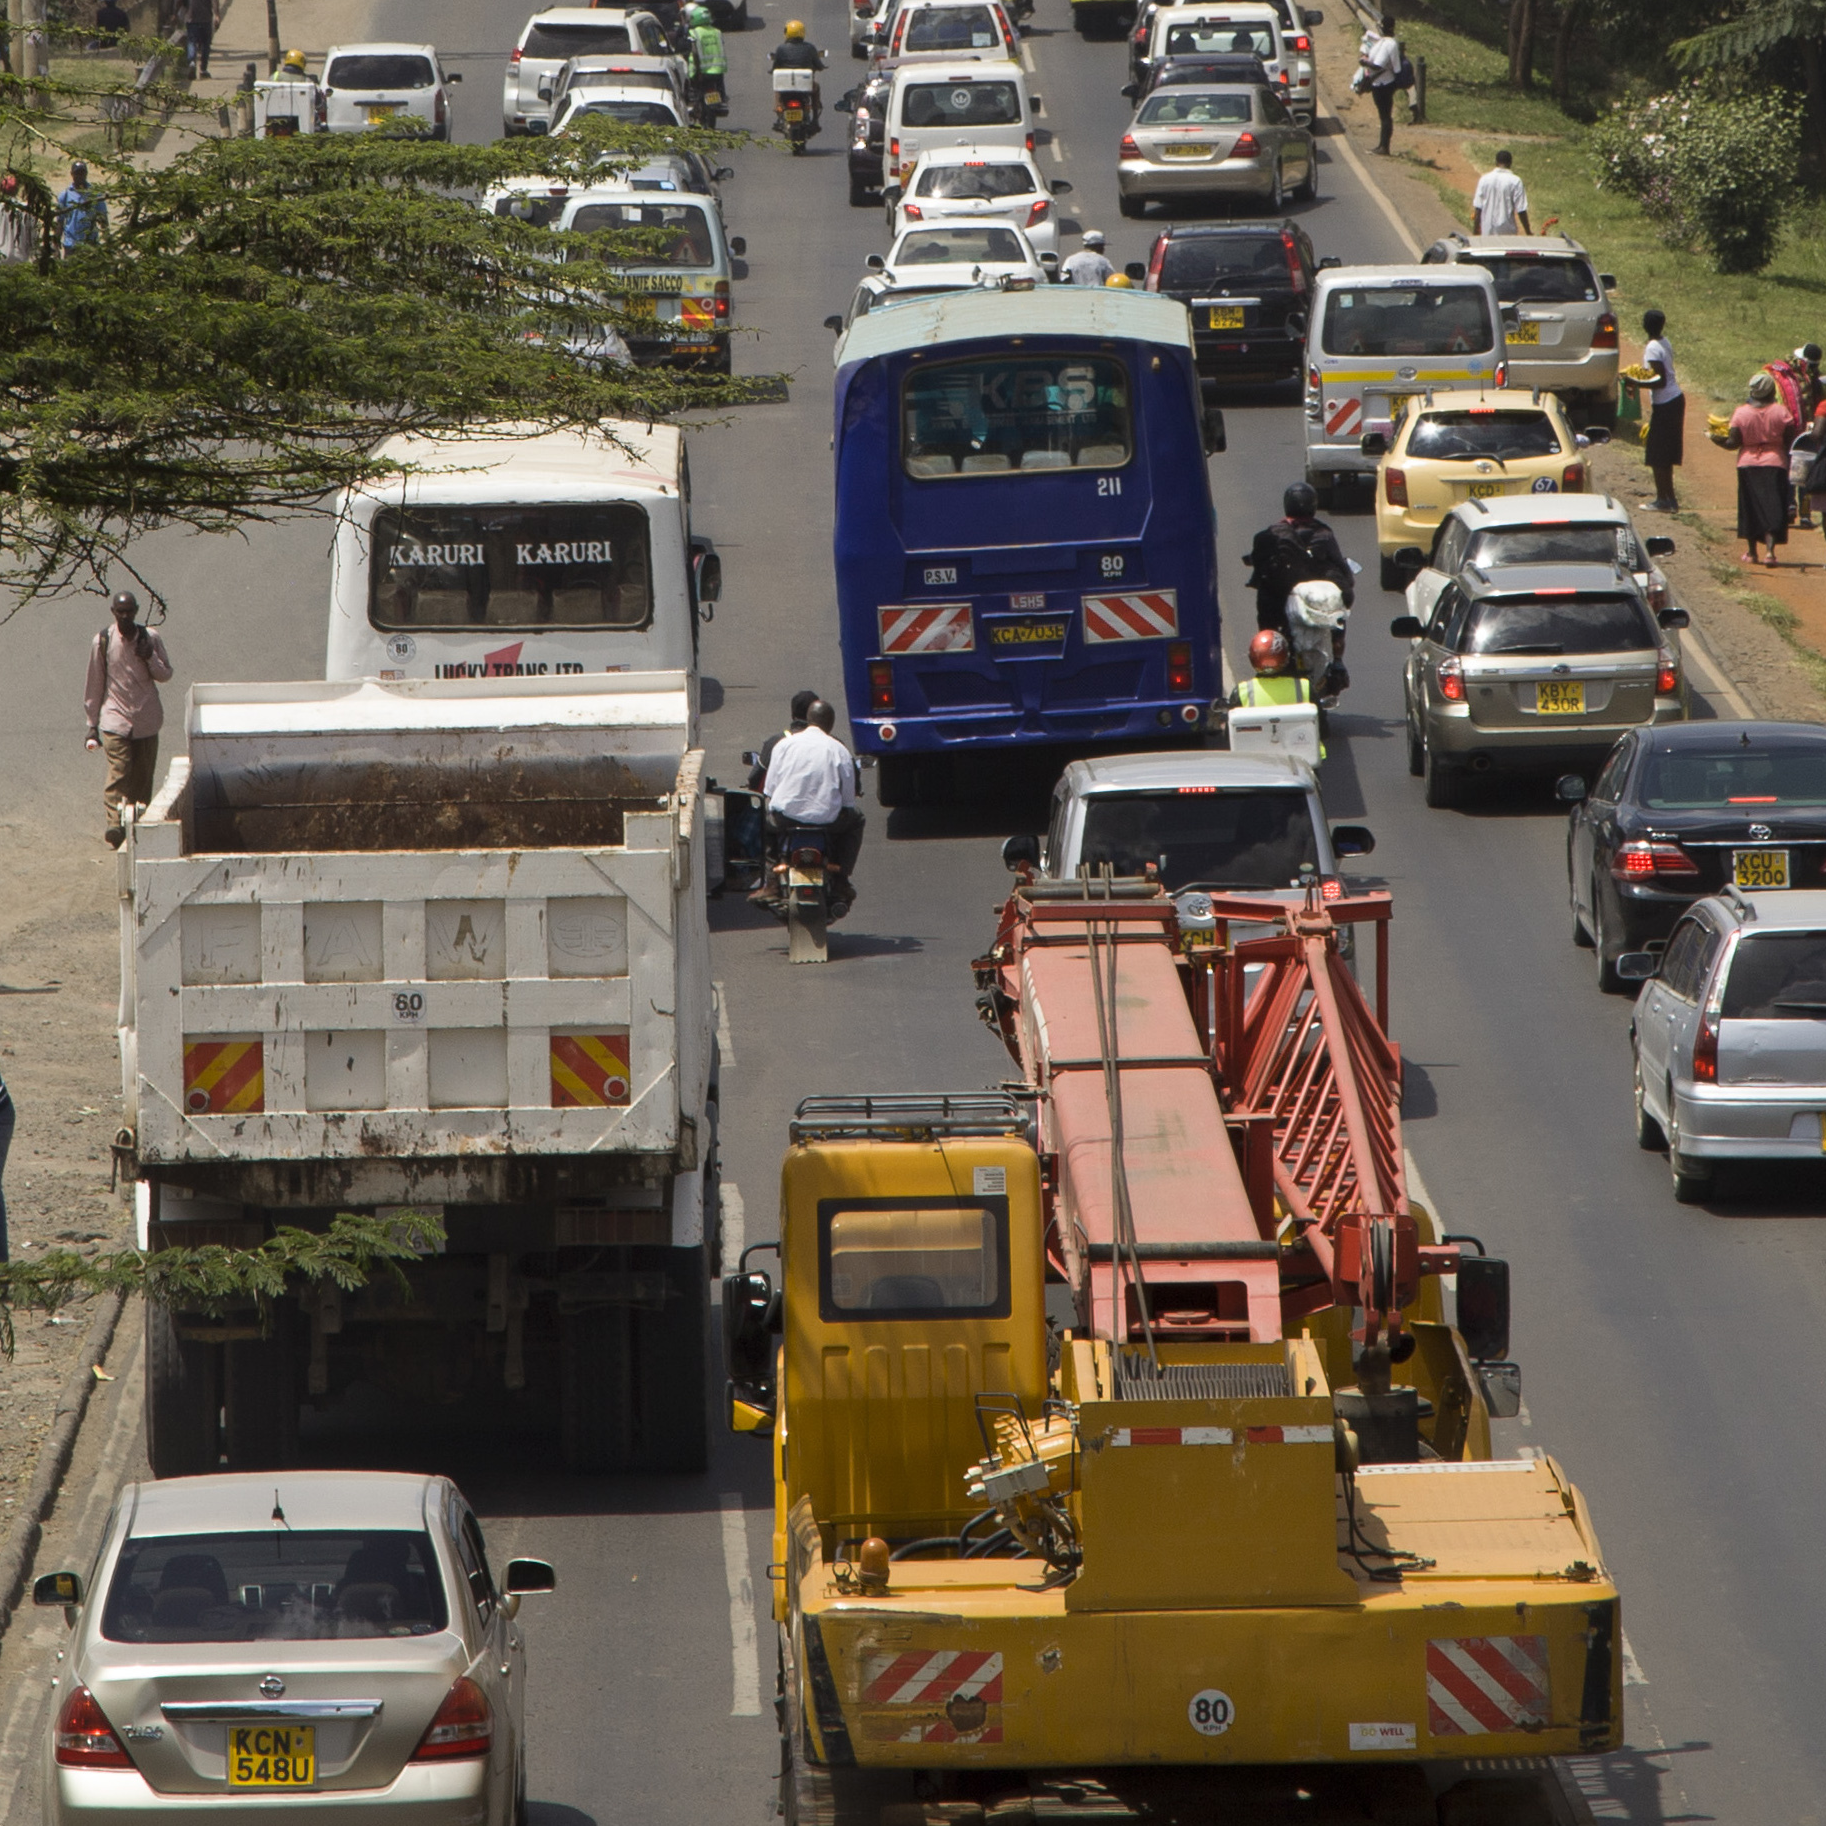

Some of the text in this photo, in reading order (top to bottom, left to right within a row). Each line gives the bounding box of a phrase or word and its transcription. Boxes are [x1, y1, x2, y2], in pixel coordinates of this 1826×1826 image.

[651, 275, 683, 292] SACCO
[979, 365, 1096, 411] KBS
[1098, 477, 1121, 496] 211
[1470, 486, 1495, 497] KCD
[1535, 479, 1553, 491] 67
[389, 541, 612, 566] KARURI KARURI
[1101, 556, 1123, 571] 80
[925, 569, 956, 584] P.S.V.
[991, 626, 1022, 644] KCA
[396, 643, 408, 654] 80
[1540, 683, 1569, 698] KBY
[1541, 697, 1580, 712] 430R
[1737, 854, 1772, 870] KCU
[395, 992, 422, 1011] 80
[1195, 1698, 1228, 1724] 80
[1203, 1724, 1221, 1732] KPH
[1379, 1727, 1405, 1736] WELL
[236, 1729, 290, 1756] KCN
[236, 1757, 310, 1782] 548U
